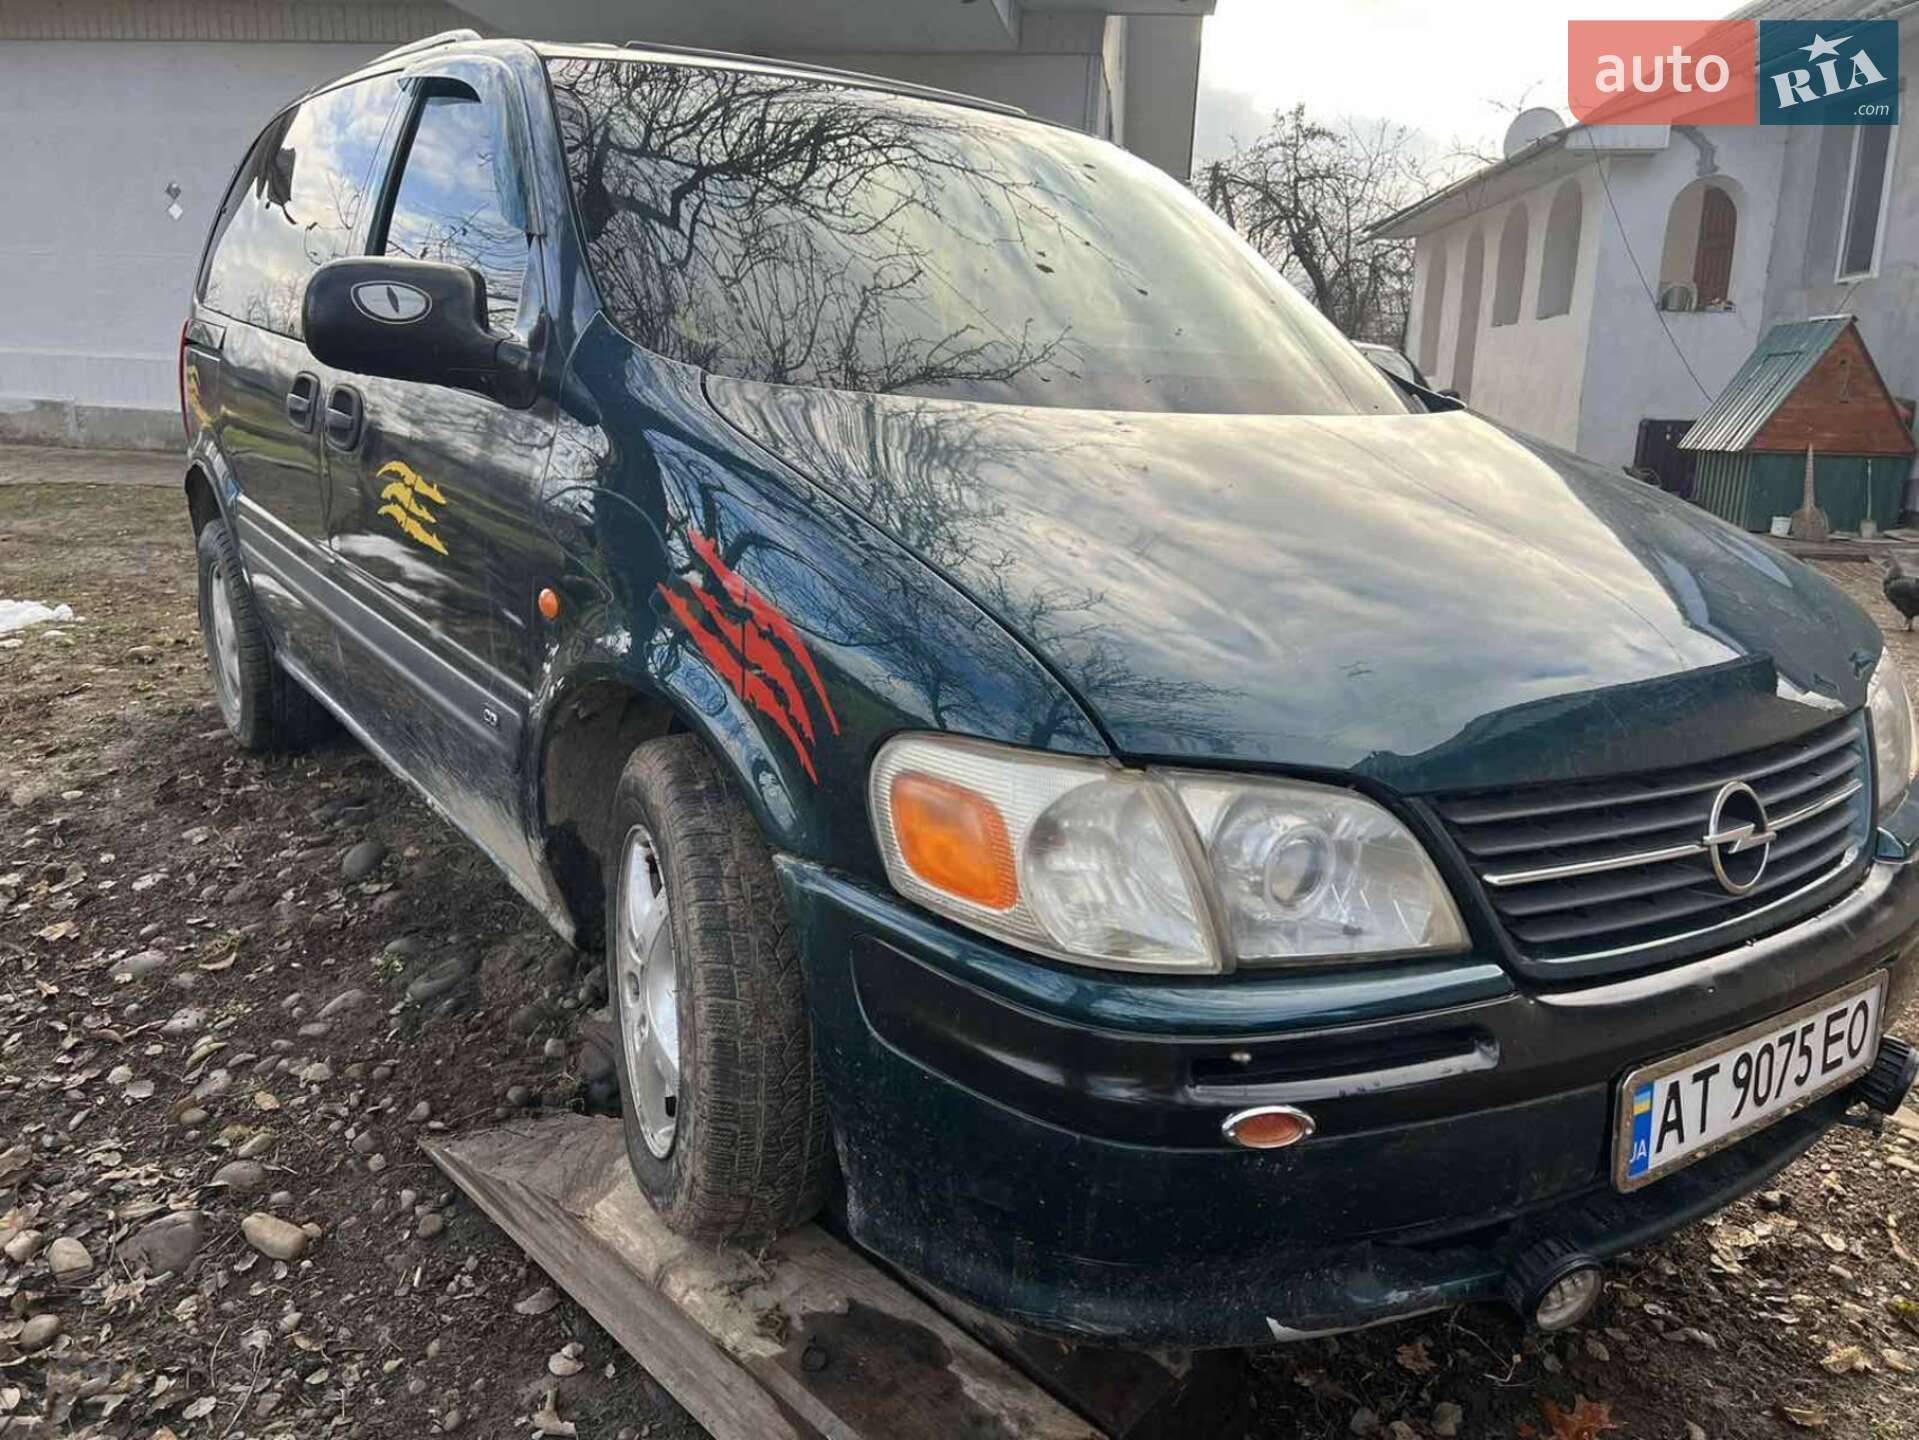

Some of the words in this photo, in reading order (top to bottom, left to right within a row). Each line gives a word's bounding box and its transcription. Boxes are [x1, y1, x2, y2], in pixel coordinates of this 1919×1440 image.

[1655, 1062, 1721, 1154] AT
[1731, 1022, 1815, 1121] 9075
[1821, 999, 1870, 1075] EO
